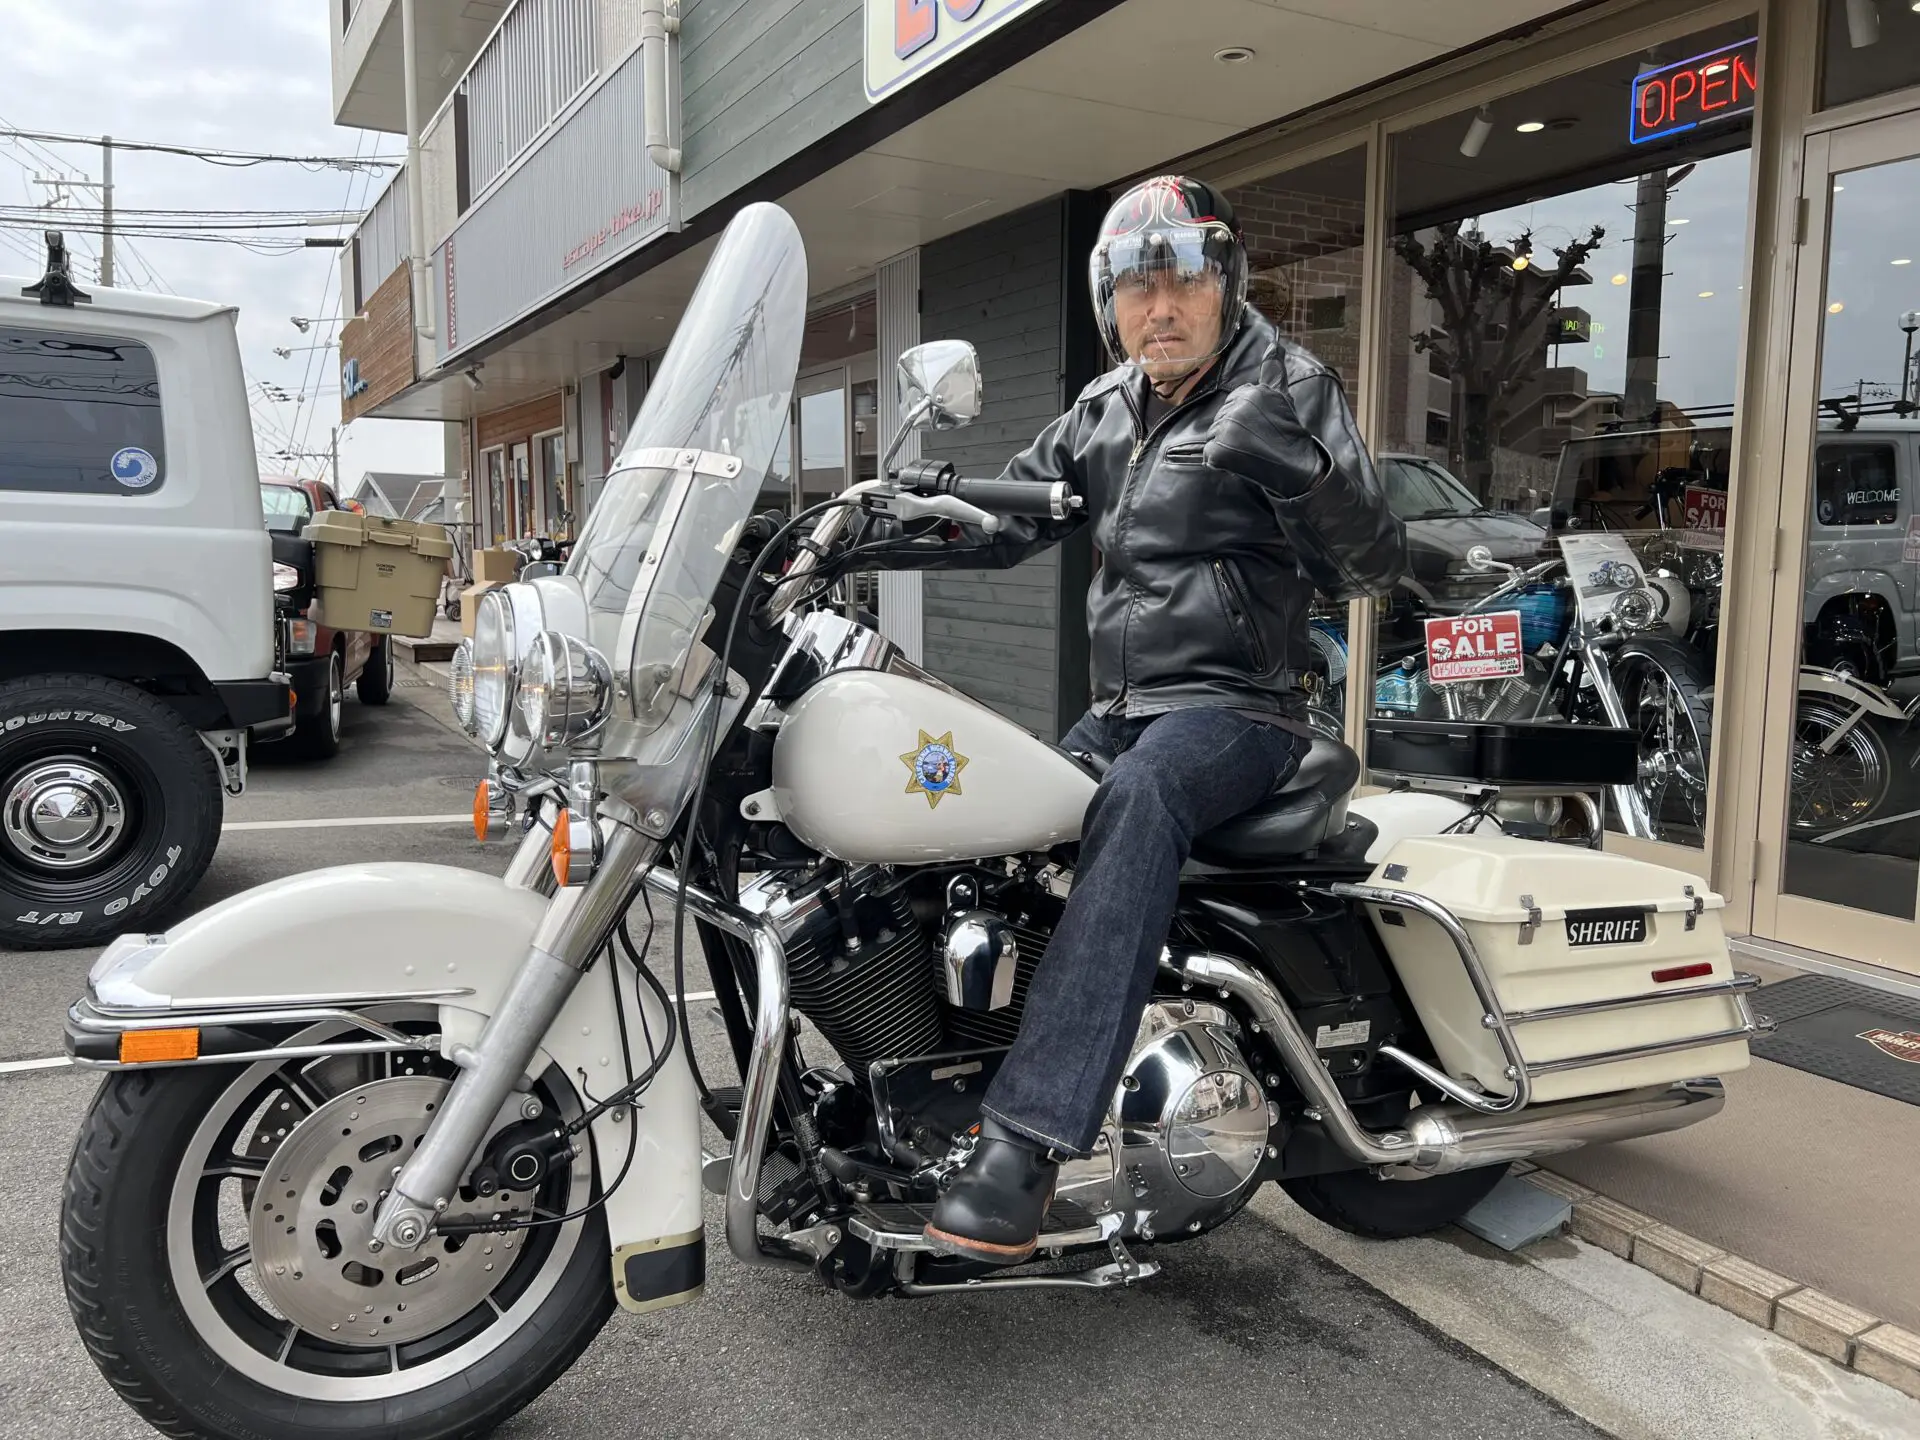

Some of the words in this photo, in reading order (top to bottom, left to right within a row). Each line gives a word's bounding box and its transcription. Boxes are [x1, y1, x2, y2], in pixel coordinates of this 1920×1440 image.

[1641, 54, 1757, 128] OPEN
[1701, 494, 1726, 511] FOR
[1847, 488, 1901, 504] WELCOME
[1686, 507, 1725, 532] SAL
[1451, 618, 1493, 635] FOR
[1432, 632, 1518, 660] SALE
[0, 709, 137, 736] OUNTRY
[103, 845, 182, 916] TOYO
[17, 911, 83, 925] R/T
[1568, 919, 1641, 944] SHERIFF
